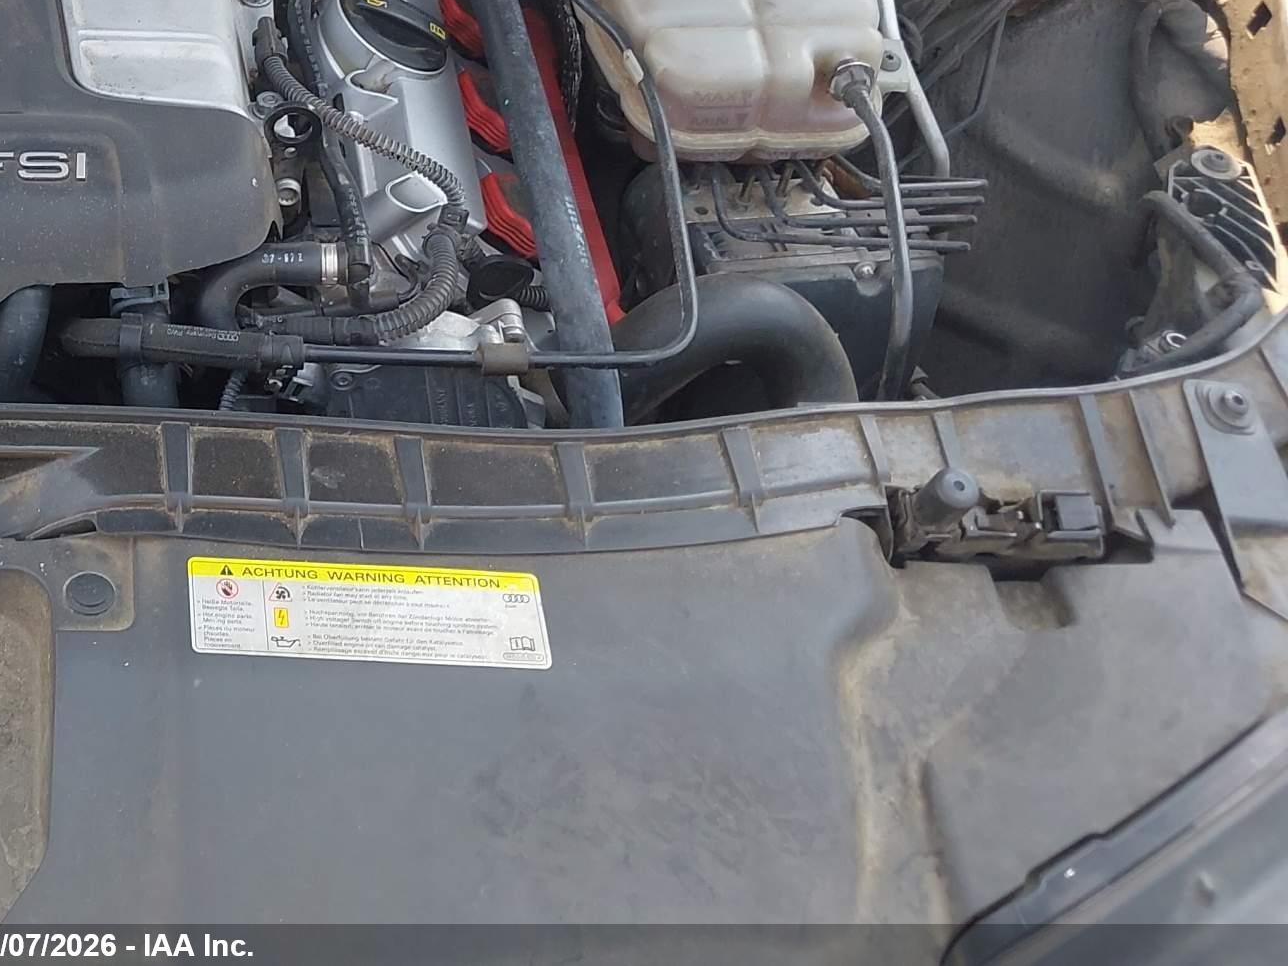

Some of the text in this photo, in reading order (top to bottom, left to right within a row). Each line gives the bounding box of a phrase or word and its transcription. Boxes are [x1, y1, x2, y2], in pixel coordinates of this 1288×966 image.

[242, 566, 501, 589] ACHTUNG WARNING ATTENTION
